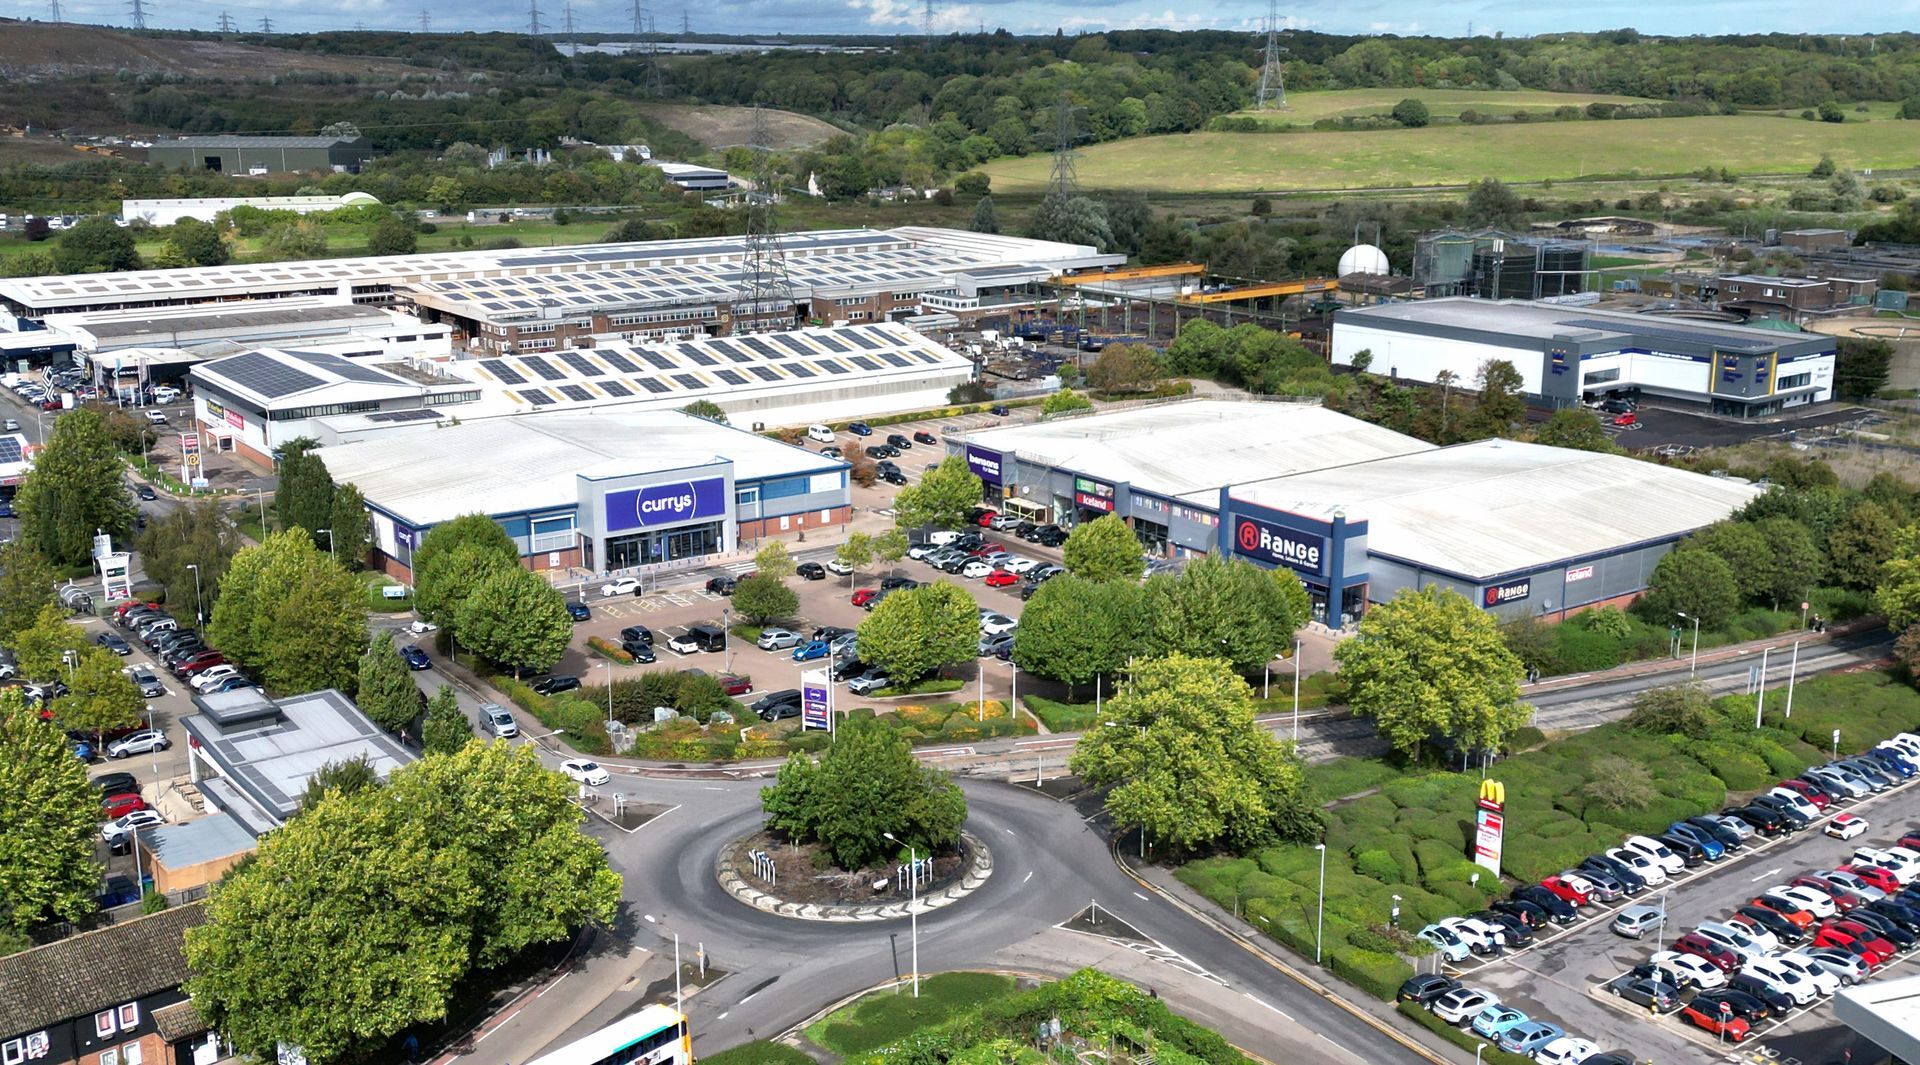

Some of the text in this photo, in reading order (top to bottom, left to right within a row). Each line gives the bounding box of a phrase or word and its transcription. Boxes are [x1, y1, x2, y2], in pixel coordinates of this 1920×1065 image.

[969, 453, 999, 470] bensons
[641, 494, 692, 513] currys
[1082, 494, 1107, 510] Iceland
[1566, 567, 1593, 582] Iceland
[1755, 1045, 1780, 1058] NO
